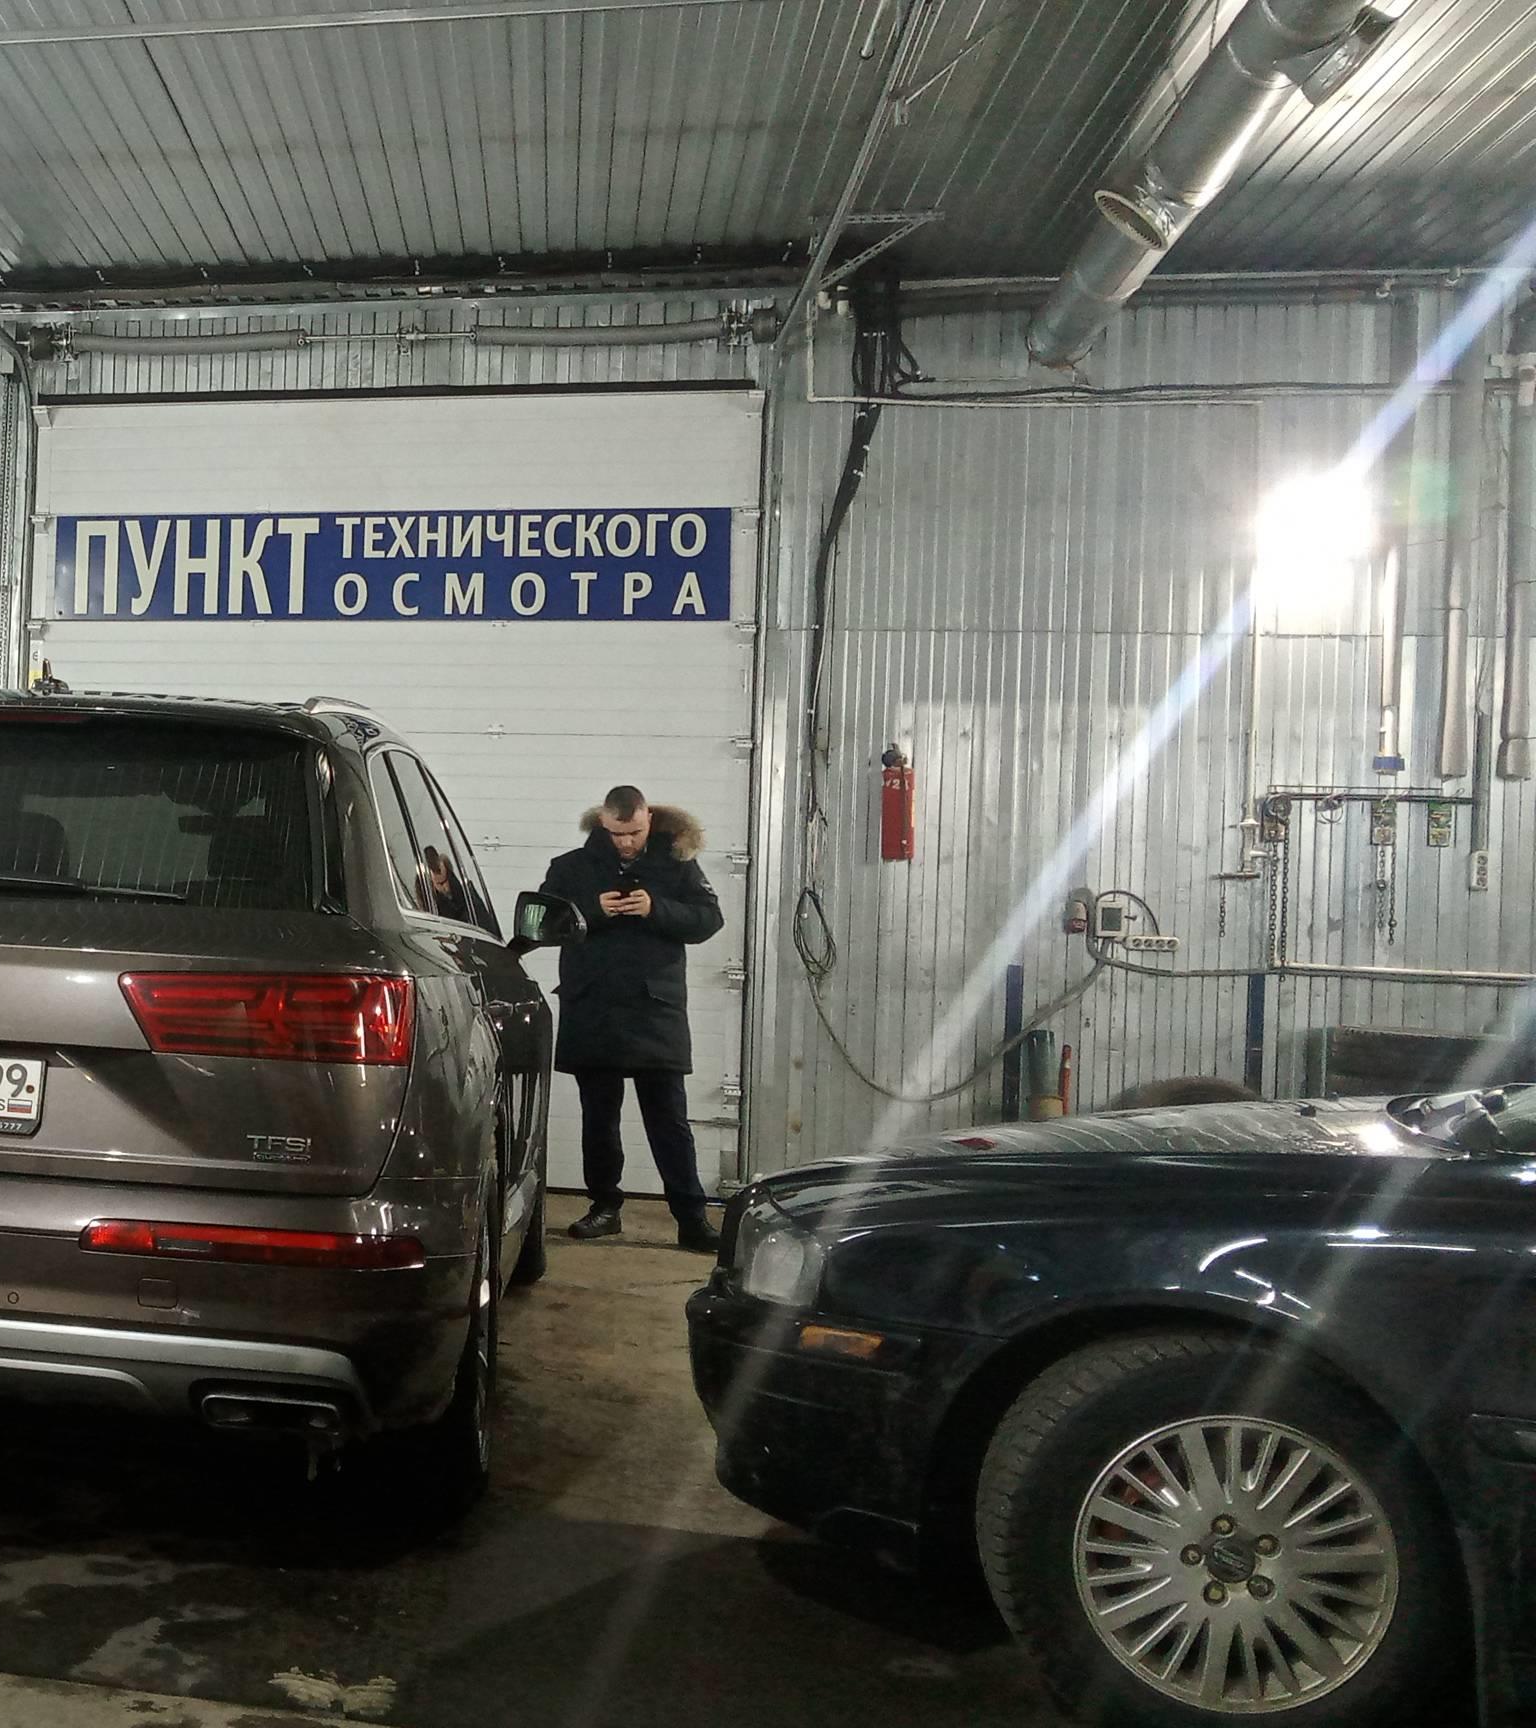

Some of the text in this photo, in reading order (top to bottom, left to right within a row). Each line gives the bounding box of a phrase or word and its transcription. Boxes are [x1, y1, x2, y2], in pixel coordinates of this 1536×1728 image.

[72, 513, 707, 616] ПУНКТ ТЕХНИЧЕСКОГО
[334, 572, 706, 616] ОСМОТРА
[246, 1134, 312, 1152] TFSI
